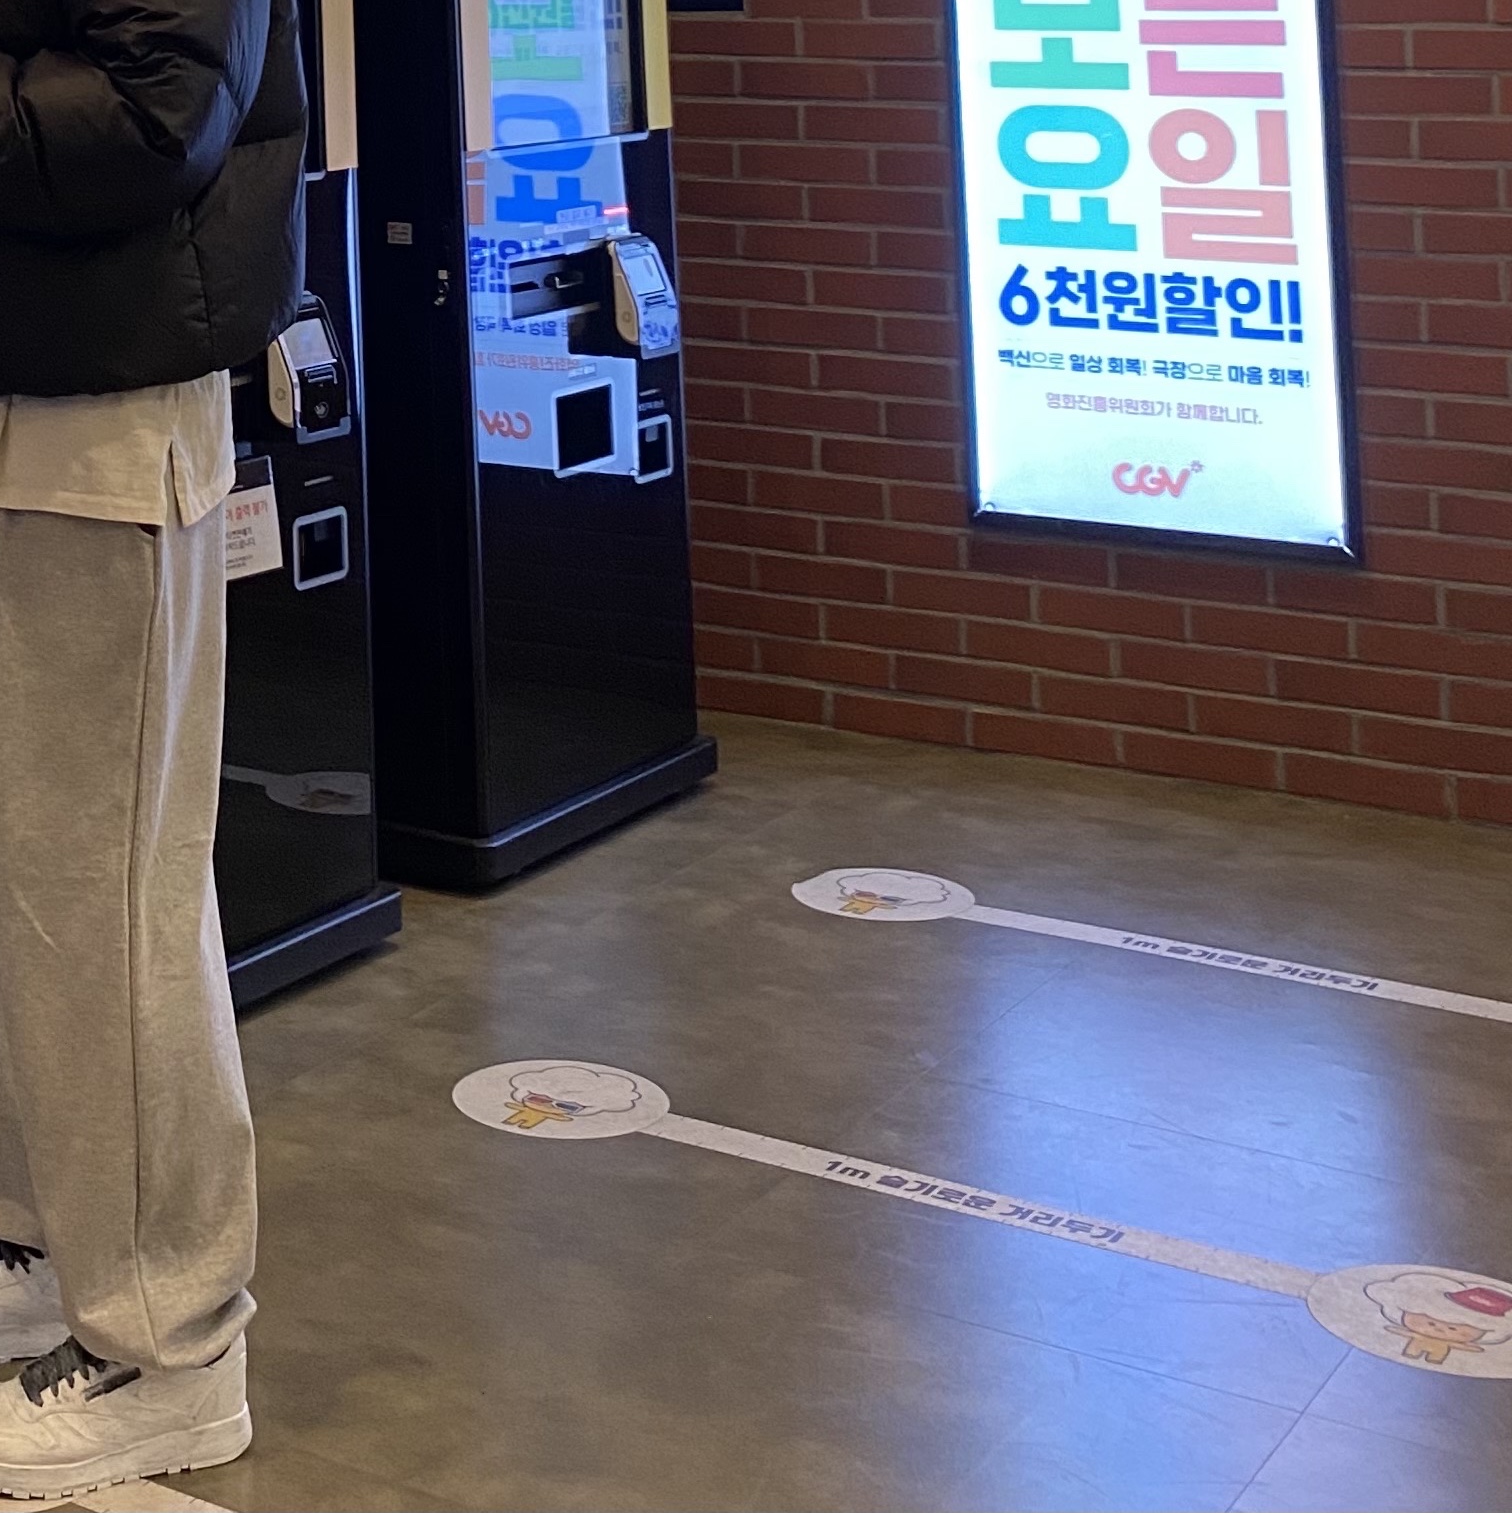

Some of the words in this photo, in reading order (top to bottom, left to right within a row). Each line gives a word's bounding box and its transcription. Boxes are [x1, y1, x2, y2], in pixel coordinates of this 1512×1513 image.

[997, 104, 1299, 266] 요일
[998, 263, 1305, 344] 6천원할인!
[997, 348, 1066, 371] 백신으로
[1069, 353, 1103, 375] 일상
[1107, 355, 1147, 377] 회복!
[1152, 358, 1224, 383] 극장으로
[1227, 365, 1263, 386] 마음
[1268, 367, 1312, 388] 회복!
[1045, 391, 1172, 419] 영화진흥위원회가
[1176, 402, 1264, 426] 함께합니다.
[1112, 462, 1190, 498] CGV
[1122, 937, 1160, 951] 1m
[1166, 945, 1269, 970] 슬기로운
[1272, 964, 1379, 991] 거리두기
[825, 1160, 871, 1180] 1m
[875, 1175, 997, 1211] 슬기로운
[999, 1203, 1126, 1244] 거리두기
